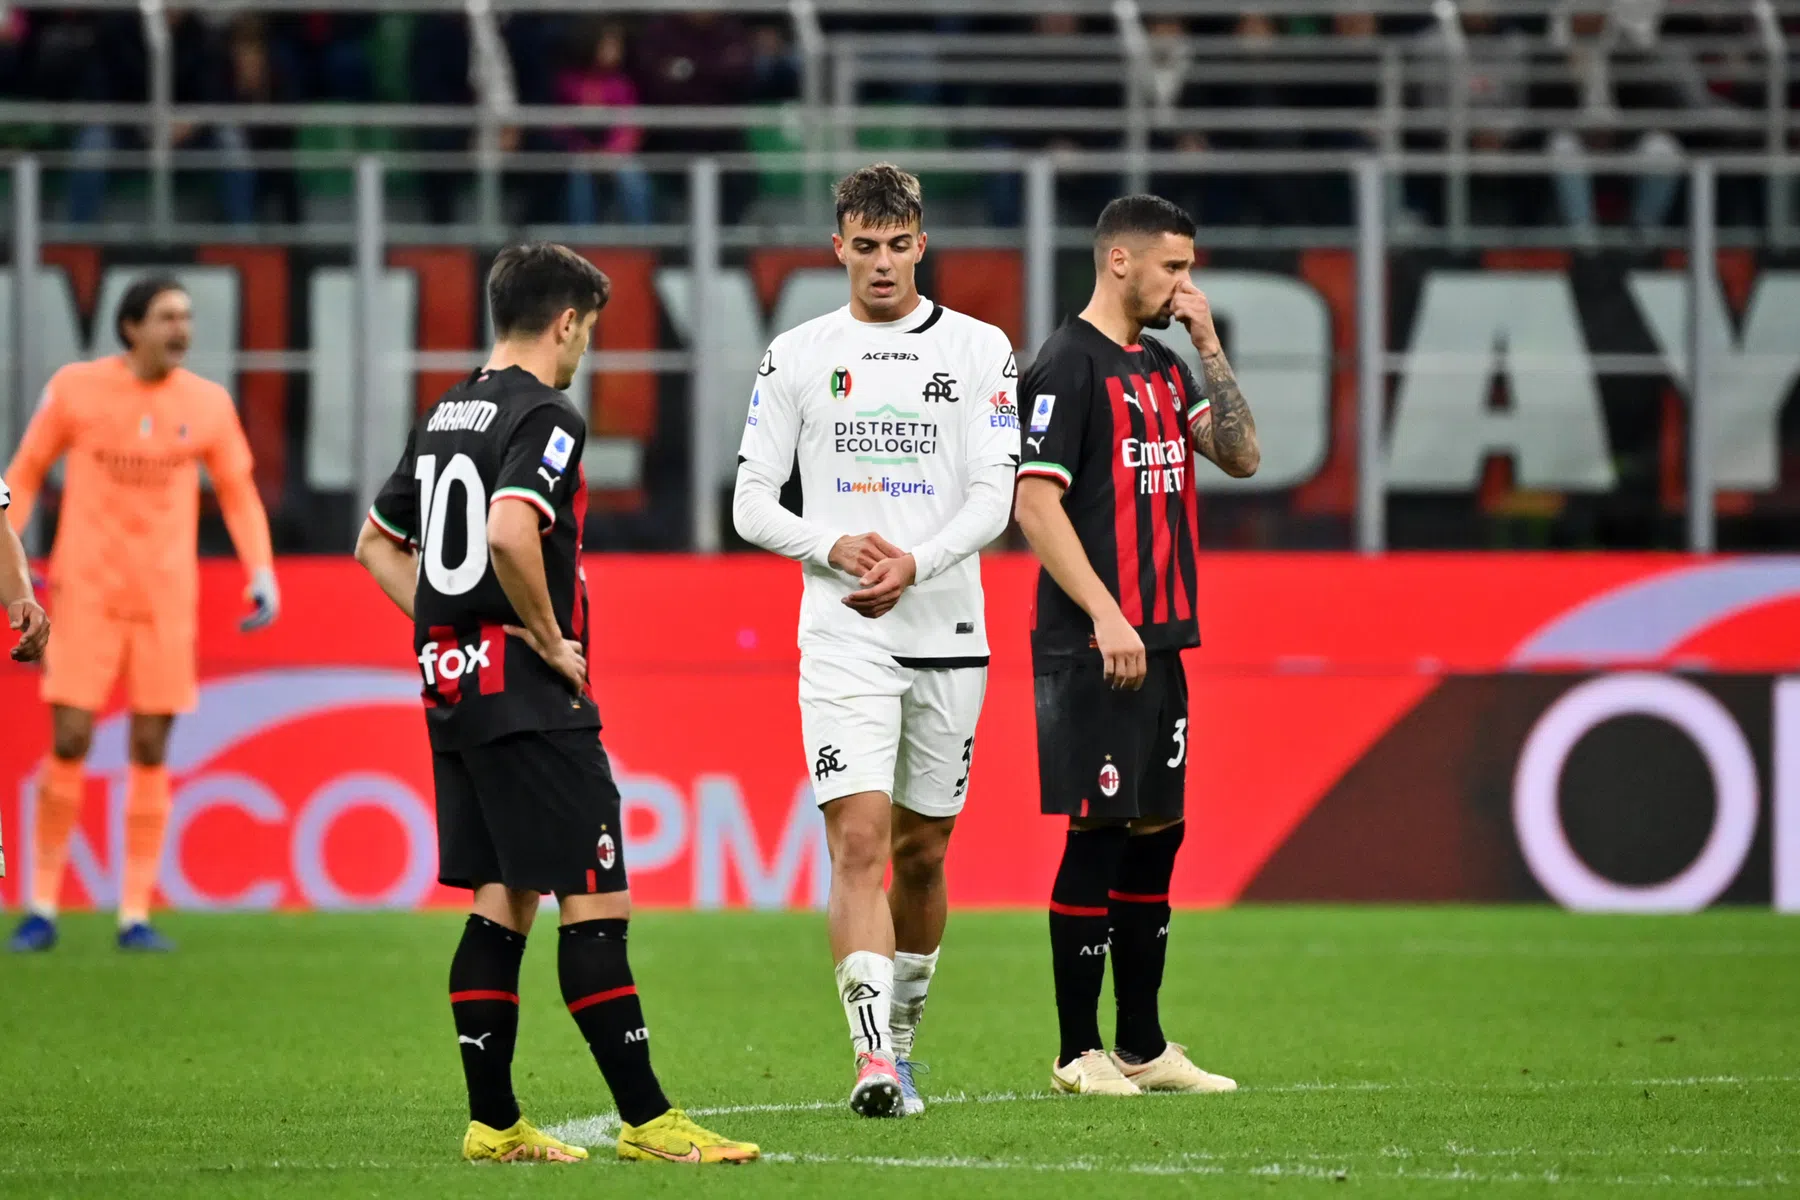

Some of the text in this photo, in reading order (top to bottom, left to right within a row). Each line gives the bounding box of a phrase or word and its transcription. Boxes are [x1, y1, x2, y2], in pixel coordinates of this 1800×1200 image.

[426, 400, 498, 432] BRAHIM
[834, 421, 938, 438] DISTRETTI
[835, 438, 936, 454] ECOLOGICI
[836, 476, 935, 497] lamialiguria
[414, 453, 488, 595] 10
[417, 640, 490, 685] fox
